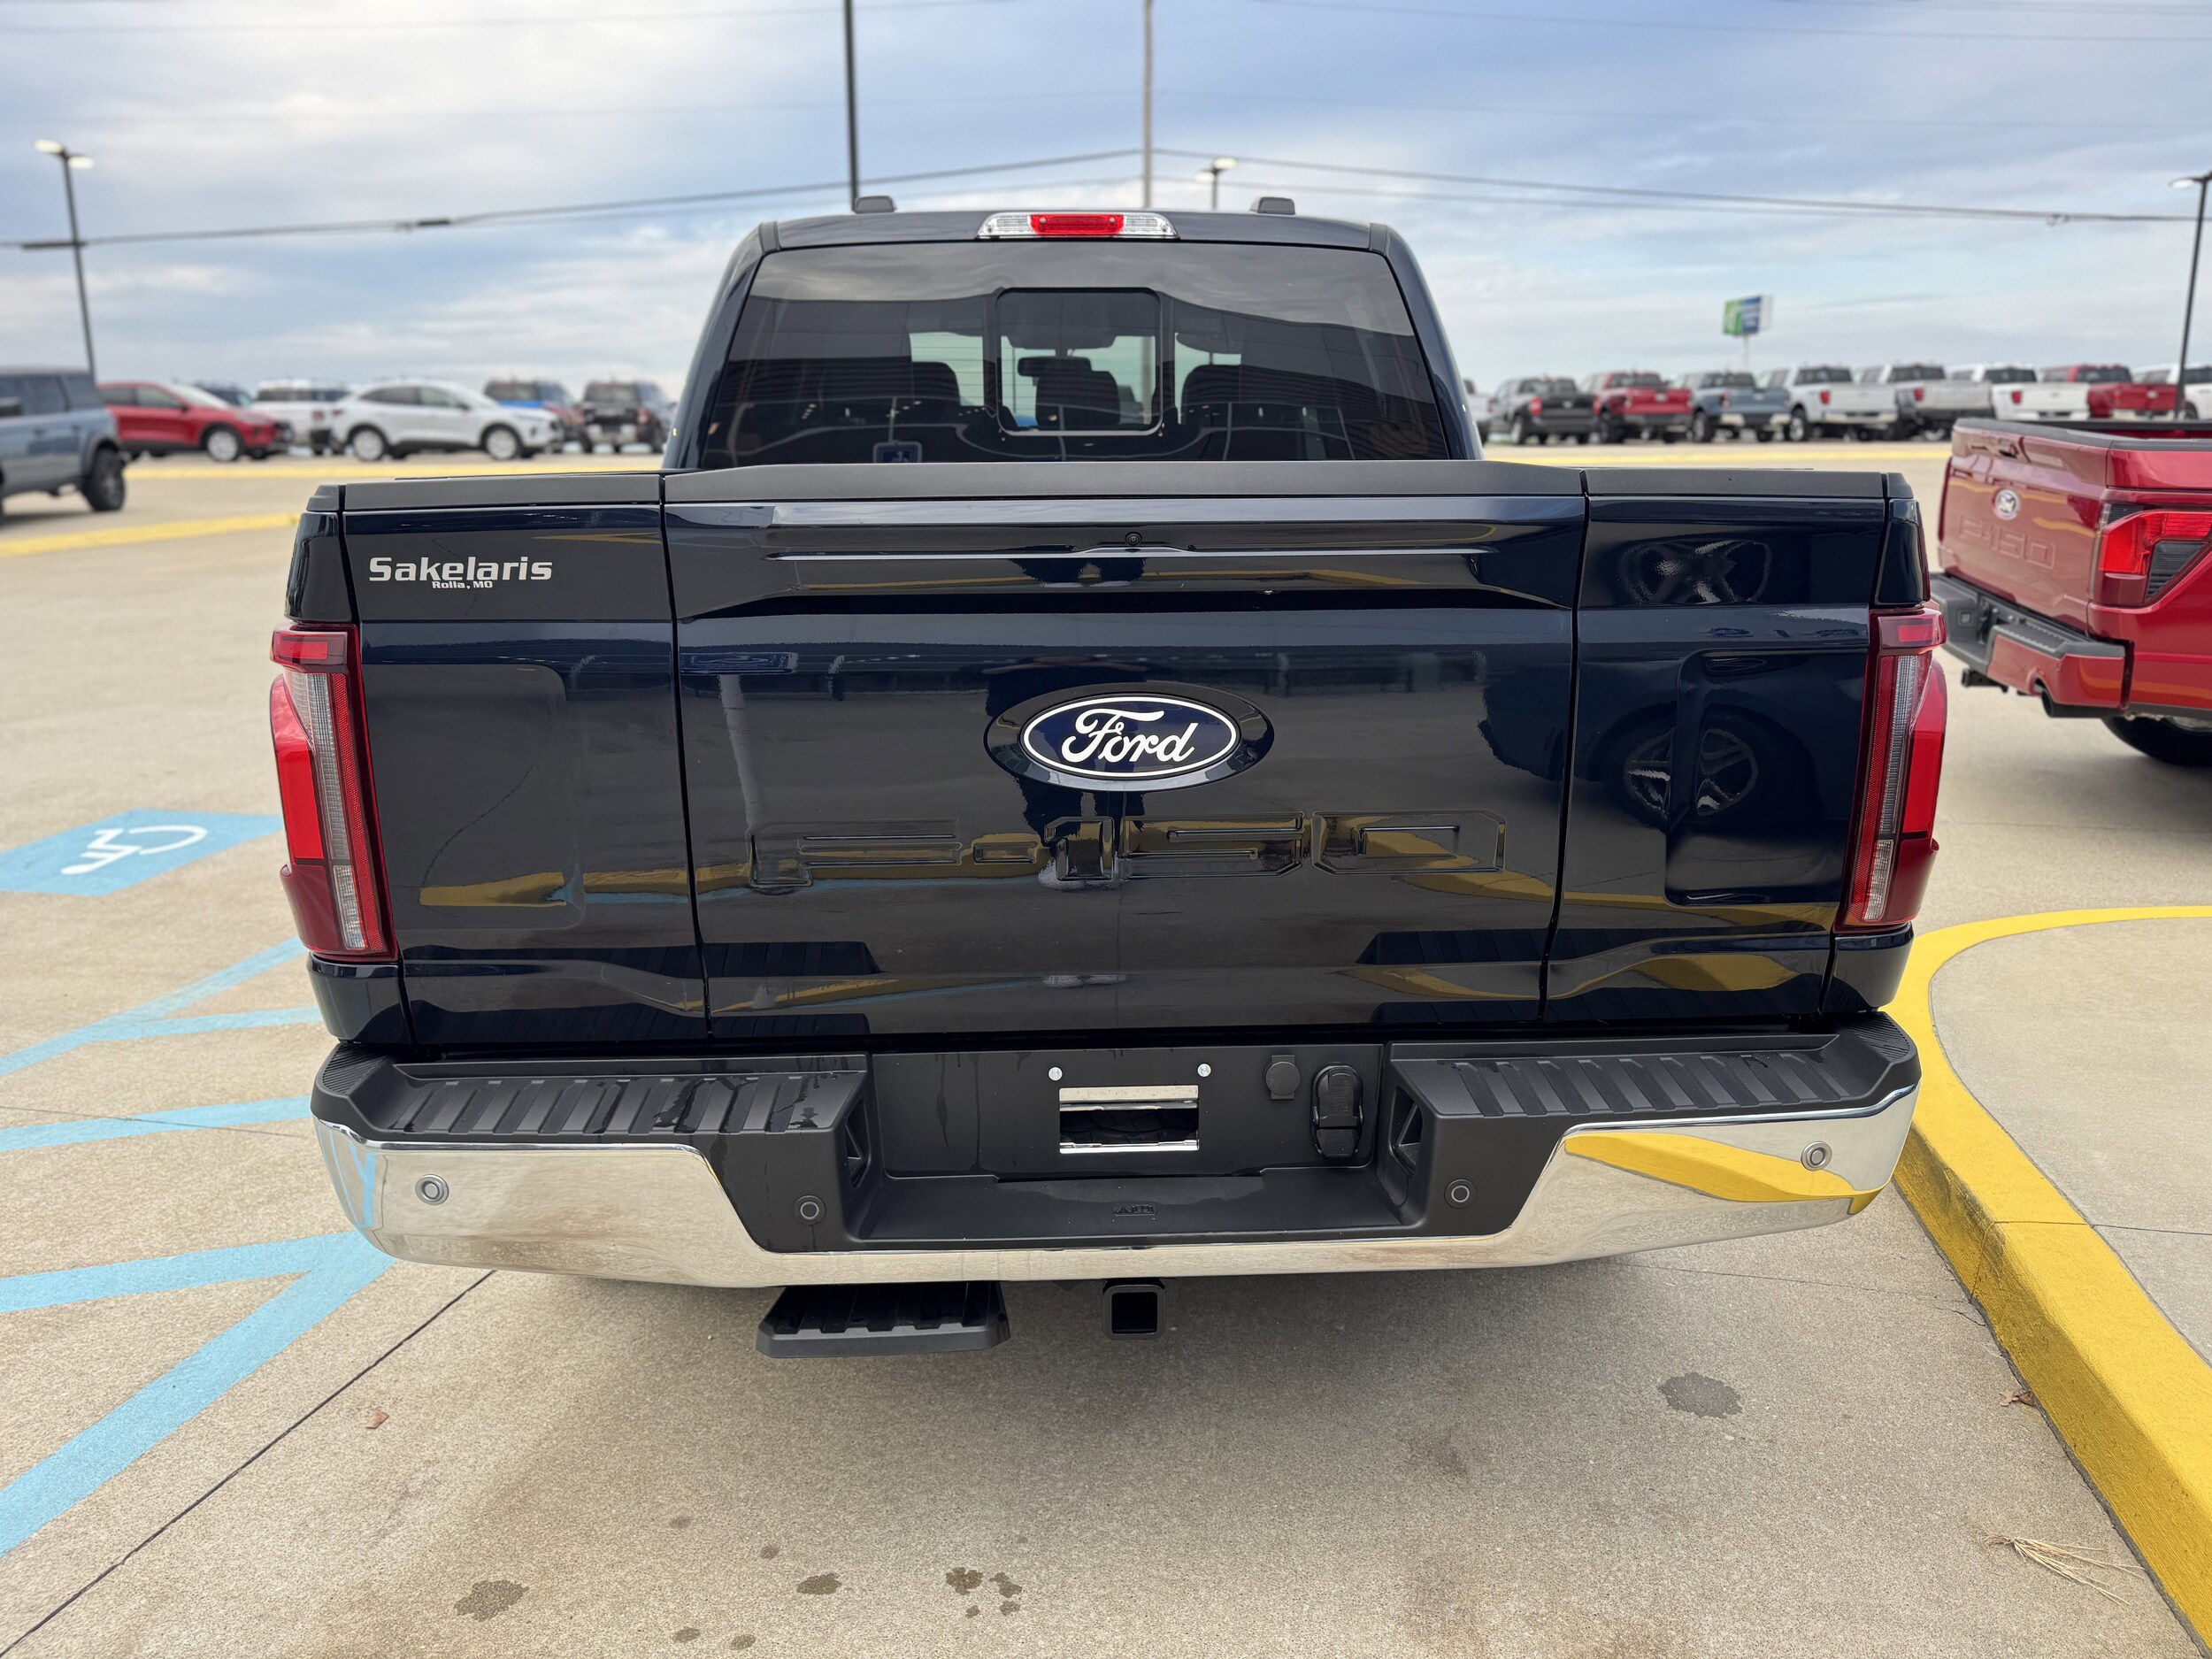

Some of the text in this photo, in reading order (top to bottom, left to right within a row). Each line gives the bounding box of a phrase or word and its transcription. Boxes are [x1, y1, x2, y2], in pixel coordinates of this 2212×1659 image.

[369, 556, 553, 581] Sakelaris
[432, 580, 471, 589] Rolla,
[1061, 708, 1199, 763] Ford
[749, 809, 1507, 886] F-150
